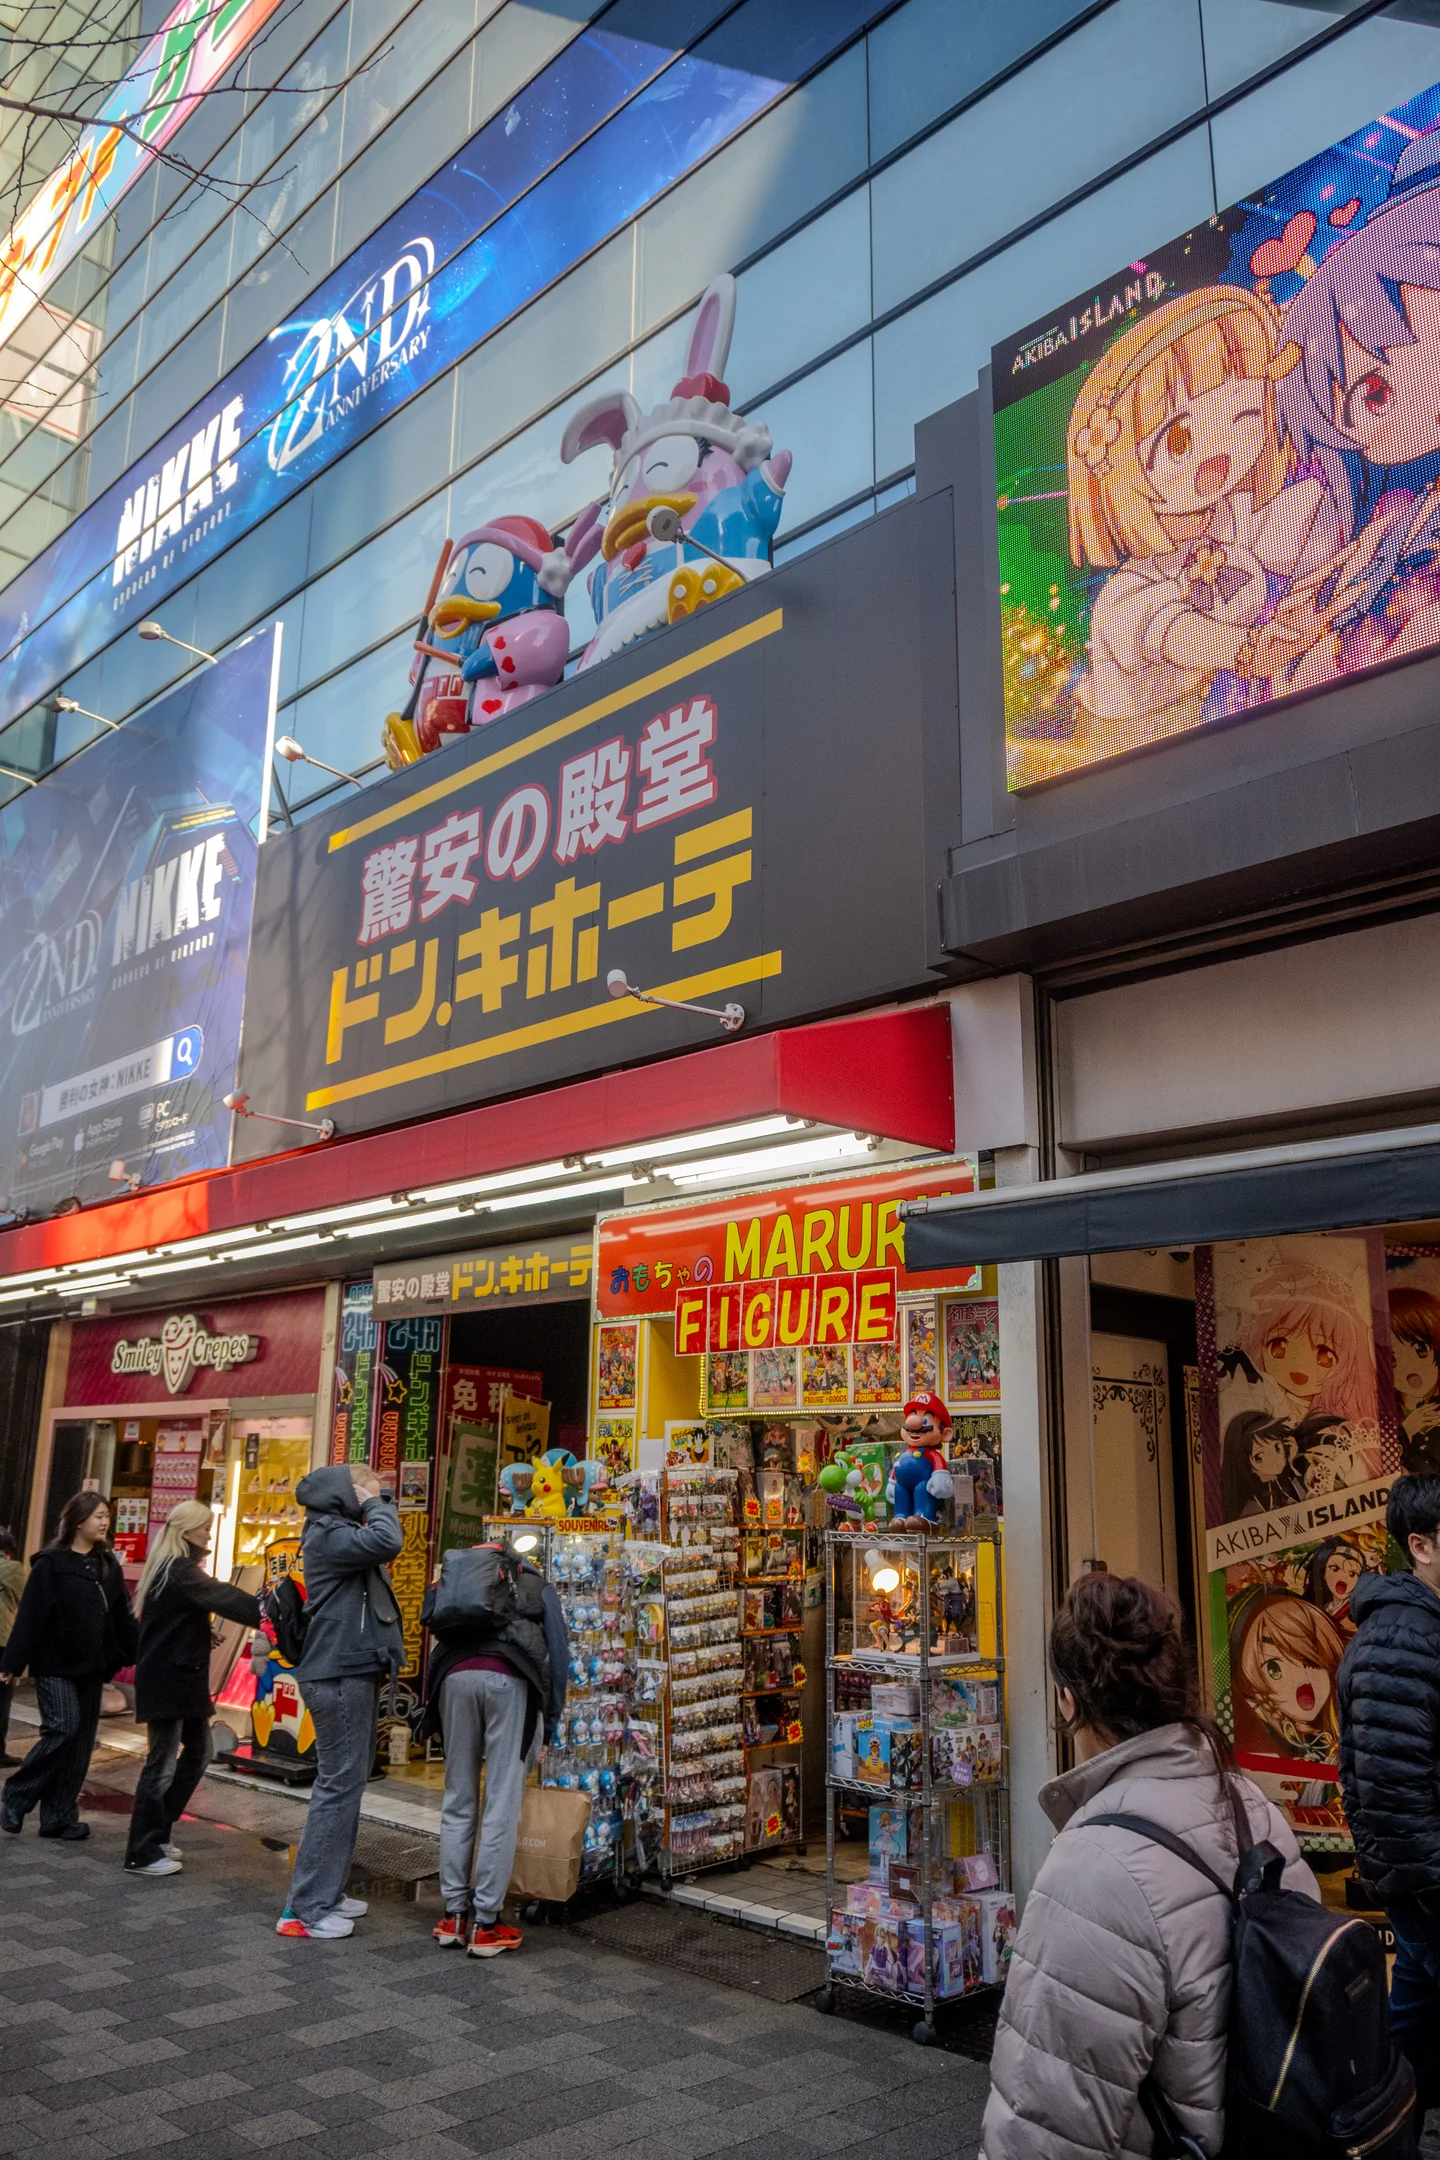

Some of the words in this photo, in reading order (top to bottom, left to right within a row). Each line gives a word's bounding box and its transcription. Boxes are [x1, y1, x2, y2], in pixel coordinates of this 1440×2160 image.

[1012, 330, 1069, 375] AKIBA
[1070, 272, 1165, 341] ISLAND
[325, 325, 431, 431] ANNIVERSARY
[112, 393, 244, 587] NIKKE
[358, 695, 718, 947] 驚安の殿堂
[111, 832, 226, 967] NIKKE
[155, 1100, 171, 1118] PC
[610, 1255, 714, 1295] おもちゃの
[724, 1190, 952, 1284] MARUR
[376, 1271, 450, 1304] 驚安の殿堂
[678, 1282, 891, 1353] FIGURE
[112, 1340, 163, 1375] Smiley
[191, 1331, 249, 1371] Crepes
[1215, 1522, 1282, 1559] AKIBA
[1307, 1487, 1391, 1529] ISLAND
